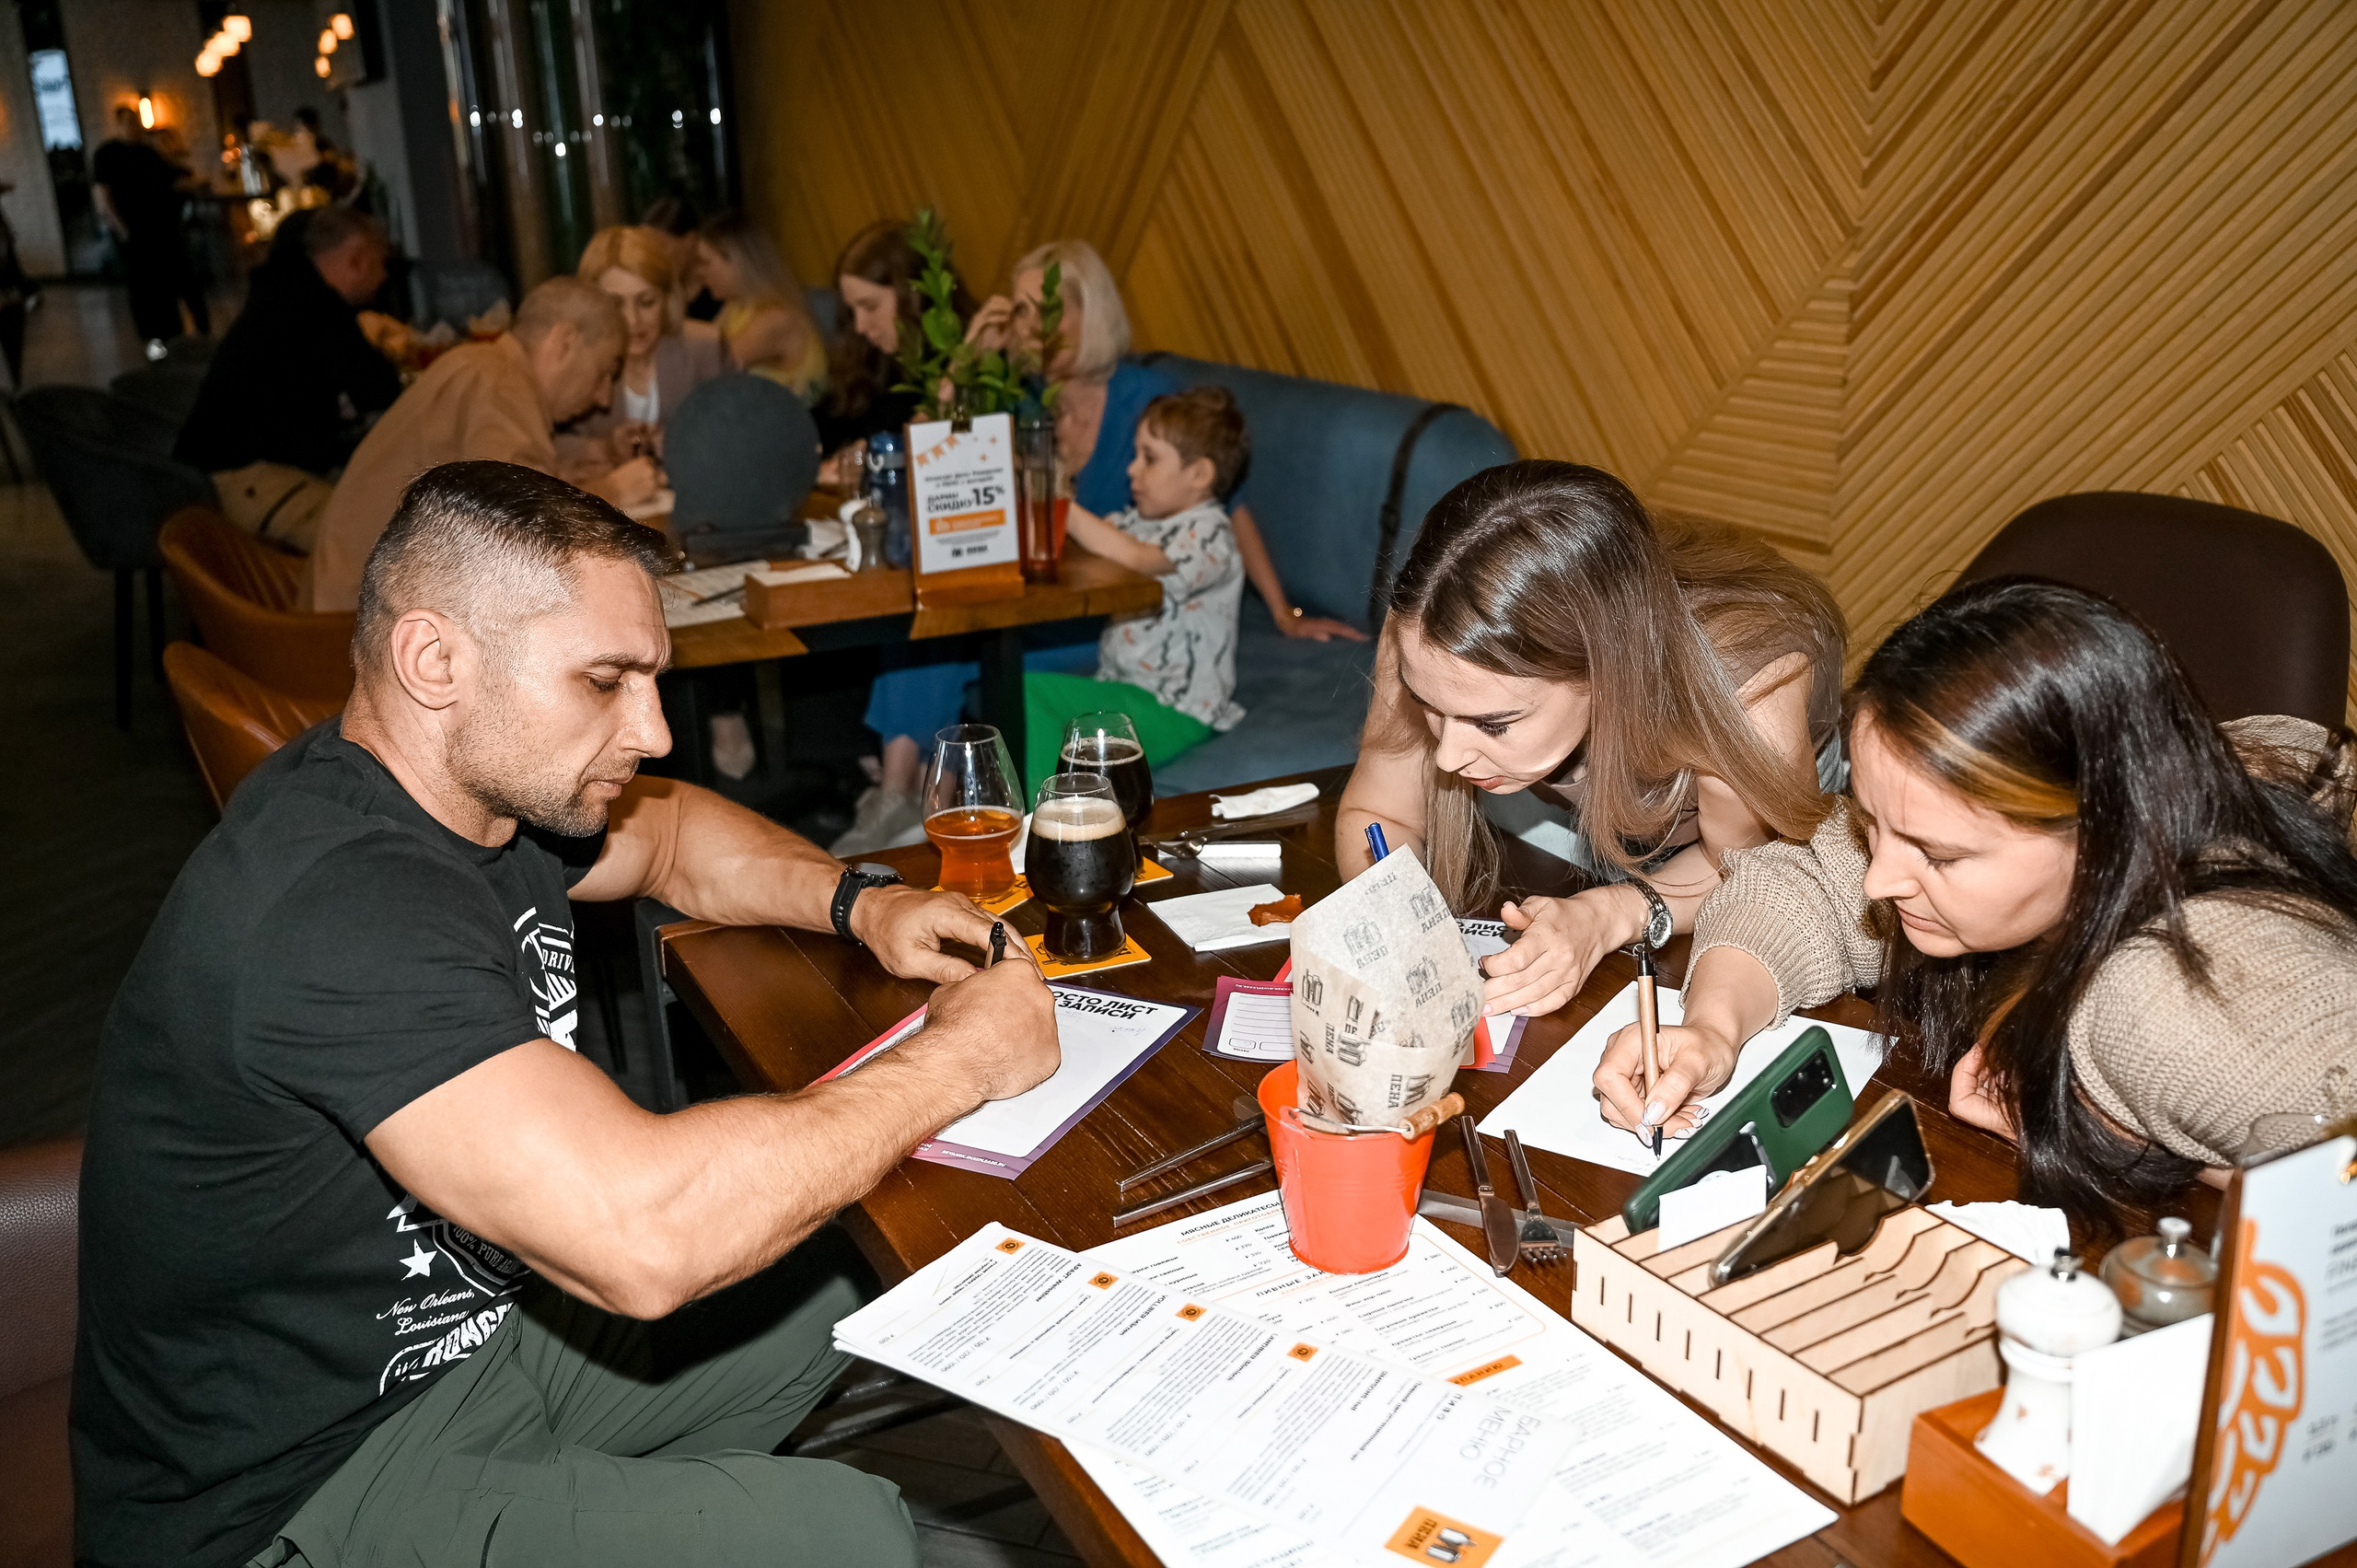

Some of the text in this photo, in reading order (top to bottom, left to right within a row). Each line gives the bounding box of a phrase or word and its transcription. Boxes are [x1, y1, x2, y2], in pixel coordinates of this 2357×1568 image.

[1469, 923, 1509, 932] ЛИС
[1053, 991, 1158, 1015] ОСТО ЛИСТ
[1058, 1001, 1137, 1020] ЗАПИСИ
[1326, 1022, 1335, 1054] ПЕНА
[1387, 1074, 1402, 1109] ПЕНА
[1180, 1201, 1281, 1237] МЯСНЫЕ ДЕЛИКАТЕСЫ
[1305, 1270, 1326, 1280] ЗАК
[376, 1288, 474, 1319] New Orleans,
[394, 1310, 470, 1336] Louisiana
[1459, 1405, 1512, 1460] МЕНЮ
[1472, 1414, 1541, 1490] БАРНОЕ
